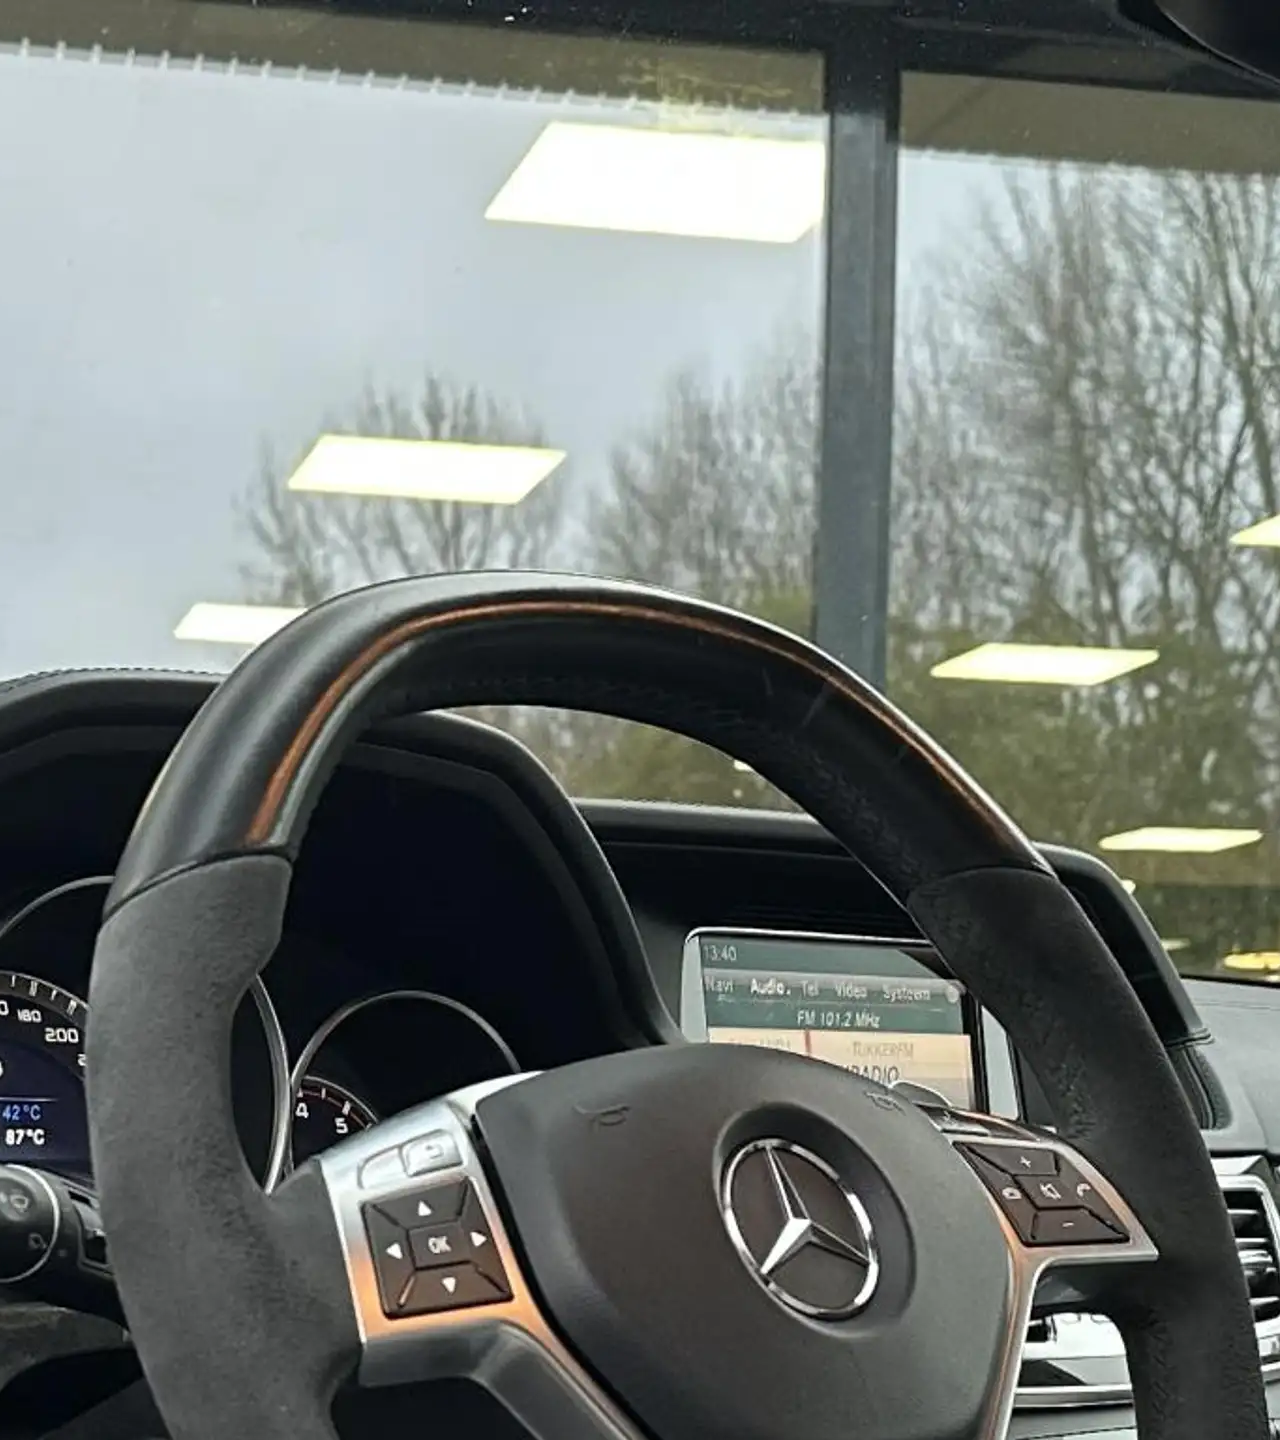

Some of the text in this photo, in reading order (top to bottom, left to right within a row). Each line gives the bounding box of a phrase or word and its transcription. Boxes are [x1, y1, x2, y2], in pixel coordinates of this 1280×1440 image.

[17, 1008, 43, 1024] 180
[797, 1008, 816, 1027] FM
[44, 1027, 80, 1044] 200
[295, 1102, 310, 1120] 4
[334, 1117, 350, 1135] 5
[428, 1235, 452, 1255] OK
